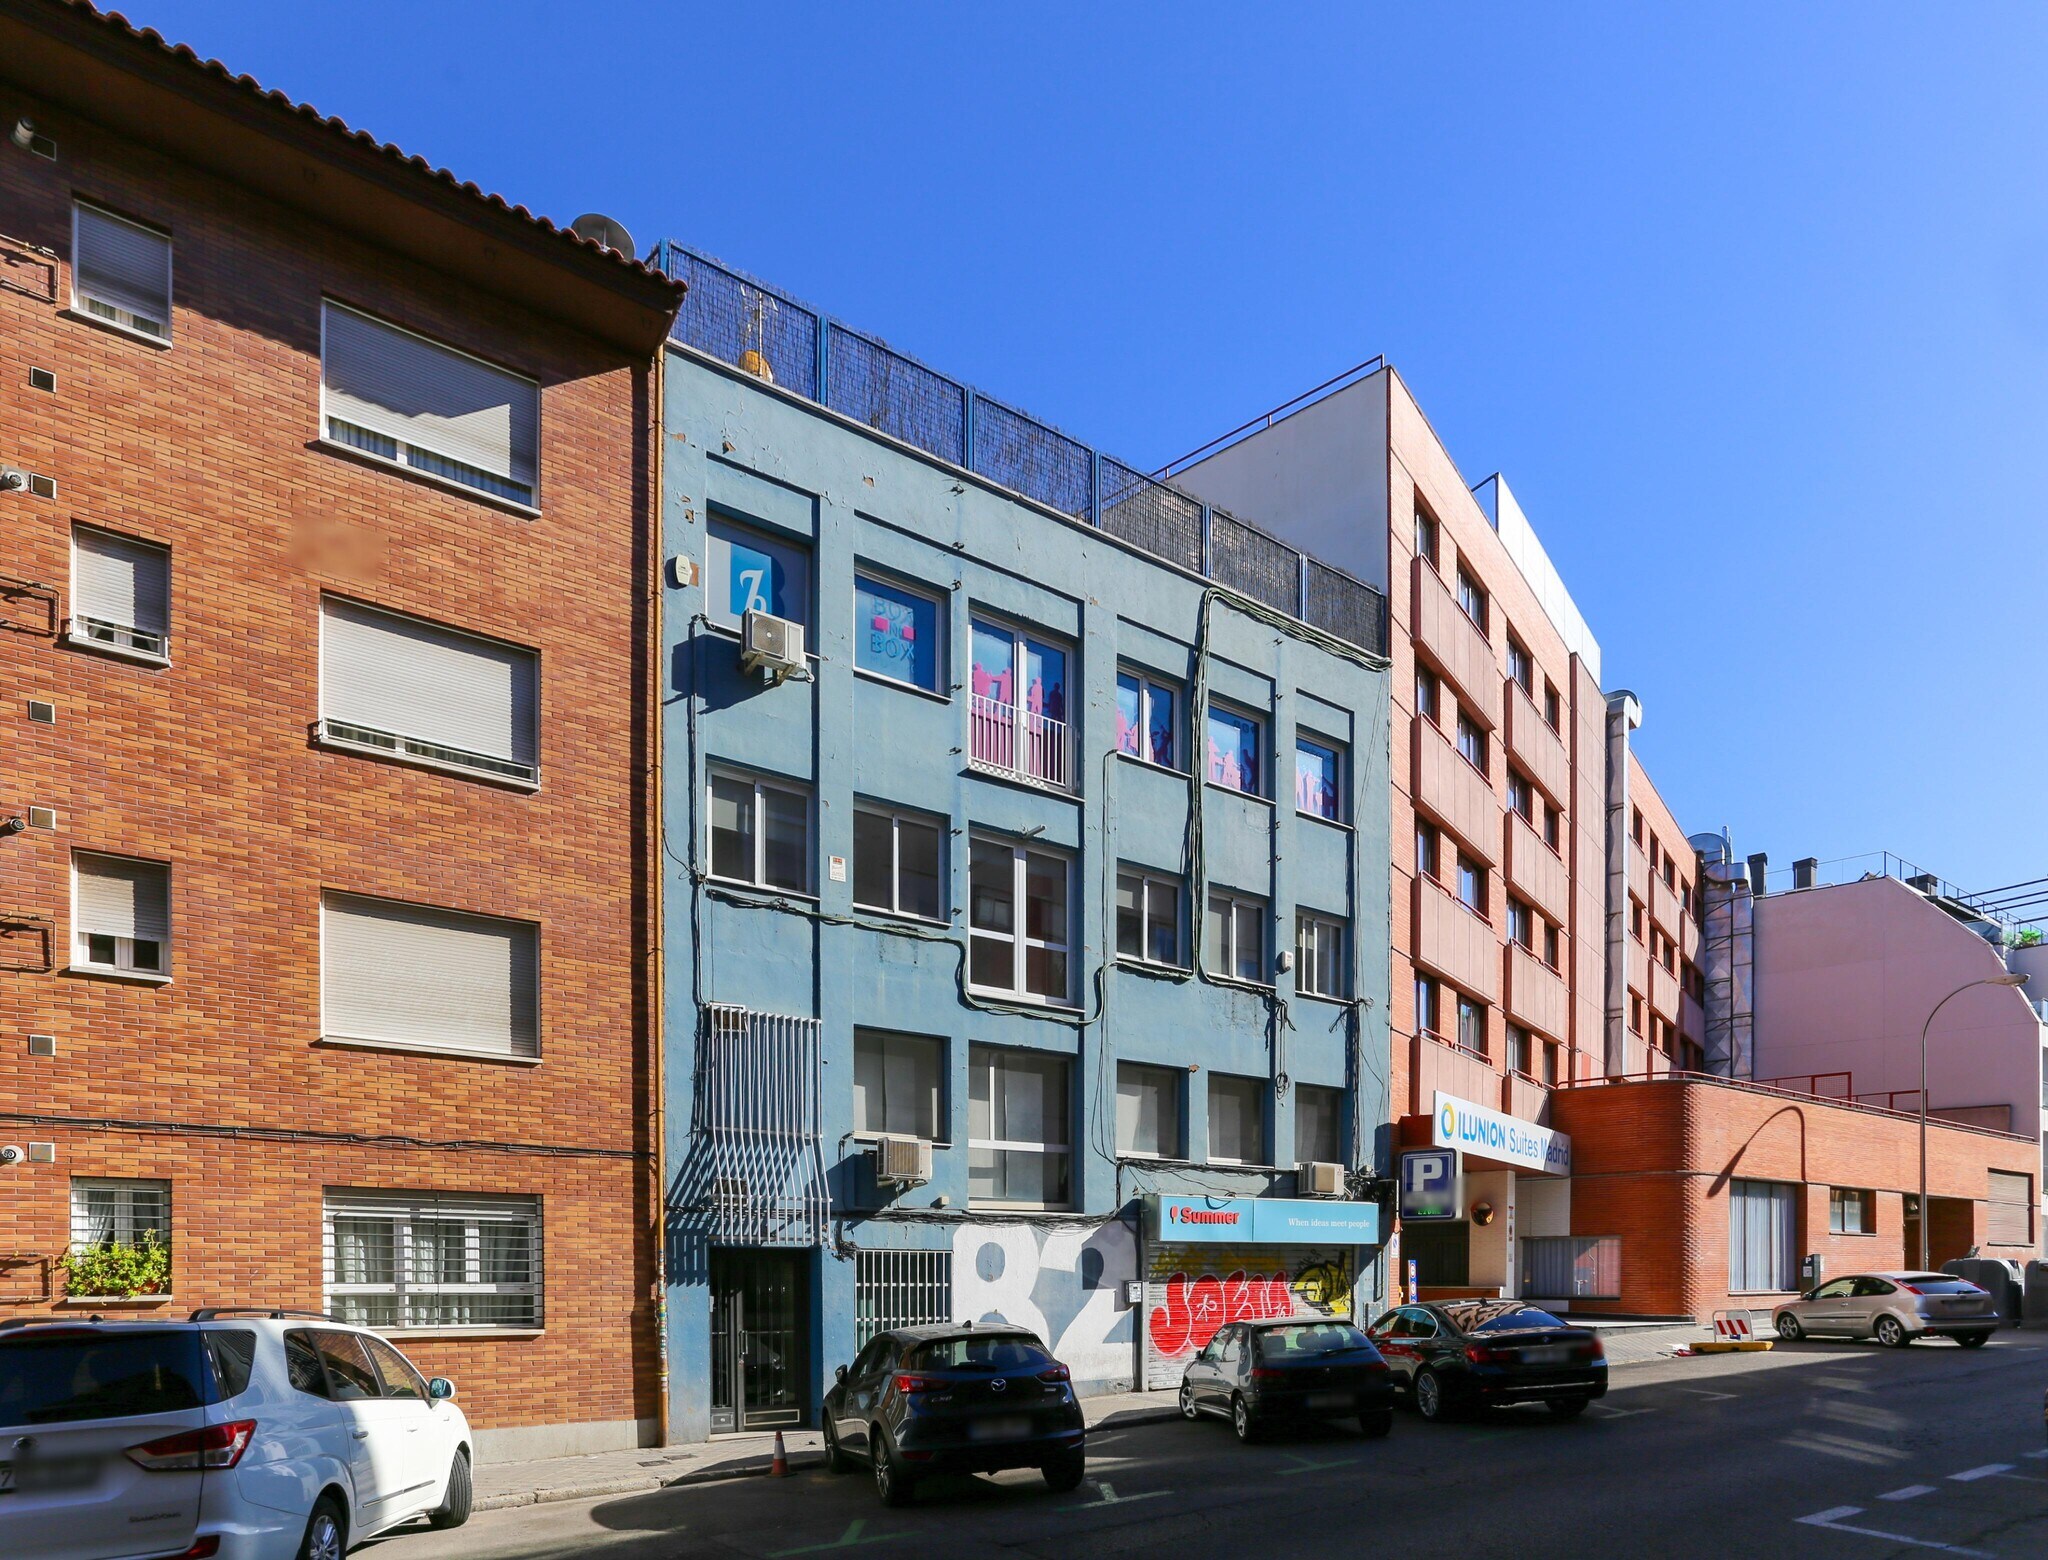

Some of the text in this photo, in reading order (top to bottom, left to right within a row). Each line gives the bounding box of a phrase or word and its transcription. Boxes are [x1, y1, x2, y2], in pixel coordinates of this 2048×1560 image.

[870, 633, 916, 662] BOX
[1458, 1111, 1569, 1166] ILUNION Suites Madrid
[1412, 1157, 1443, 1192] P
[1180, 1207, 1240, 1225] Summer
[1288, 1217, 1370, 1229] When ideas meet people
